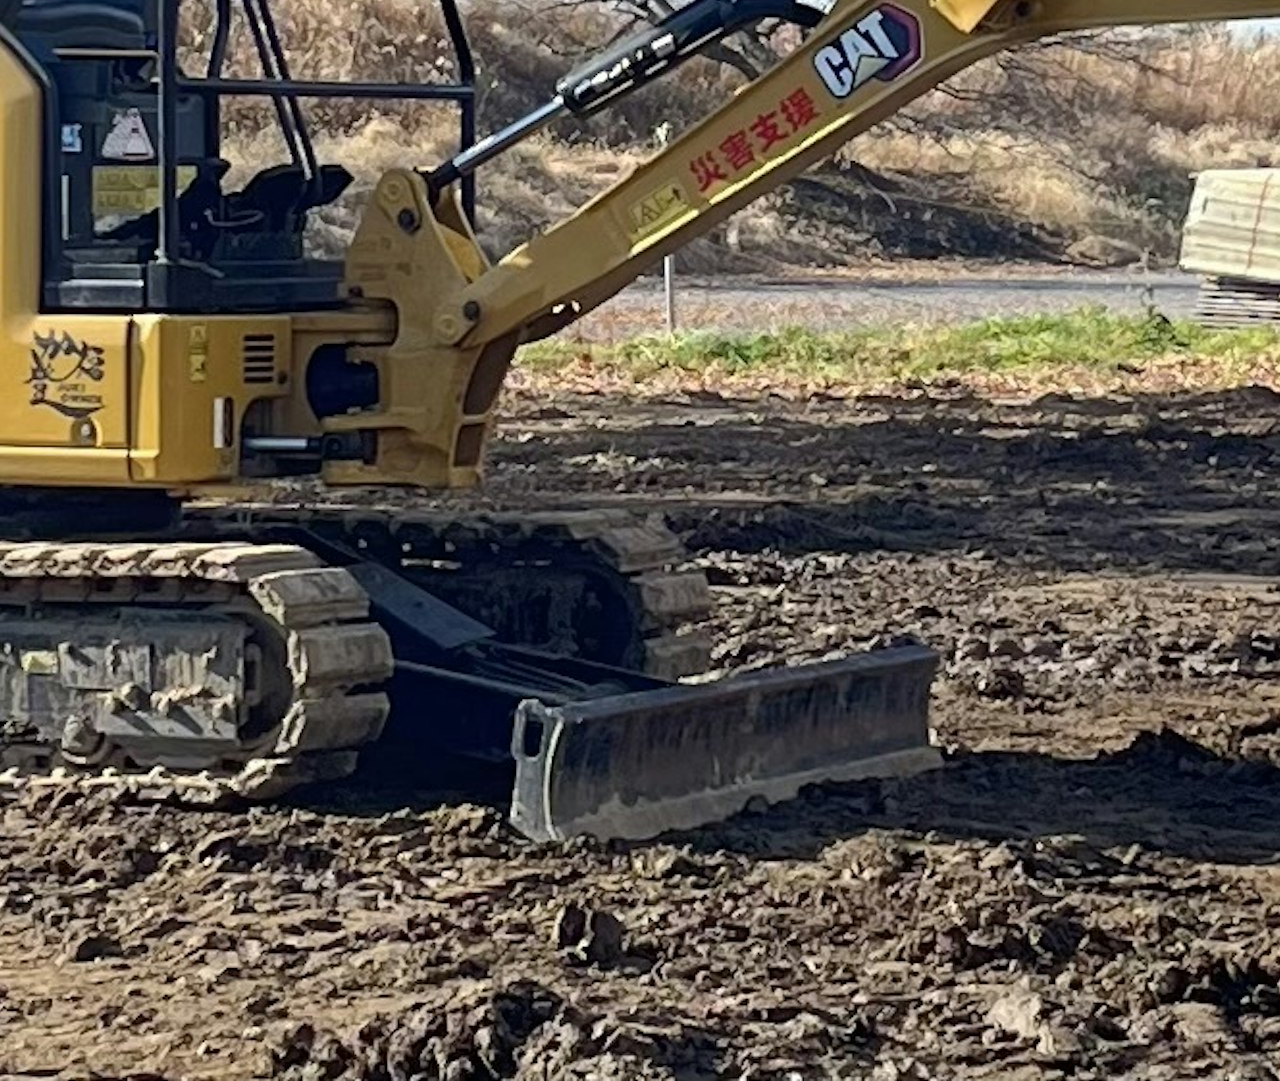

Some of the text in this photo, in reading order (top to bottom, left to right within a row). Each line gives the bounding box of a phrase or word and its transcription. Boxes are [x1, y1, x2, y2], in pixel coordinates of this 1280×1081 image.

[813, 9, 900, 97] CAT
[690, 87, 820, 192] 災害支援
